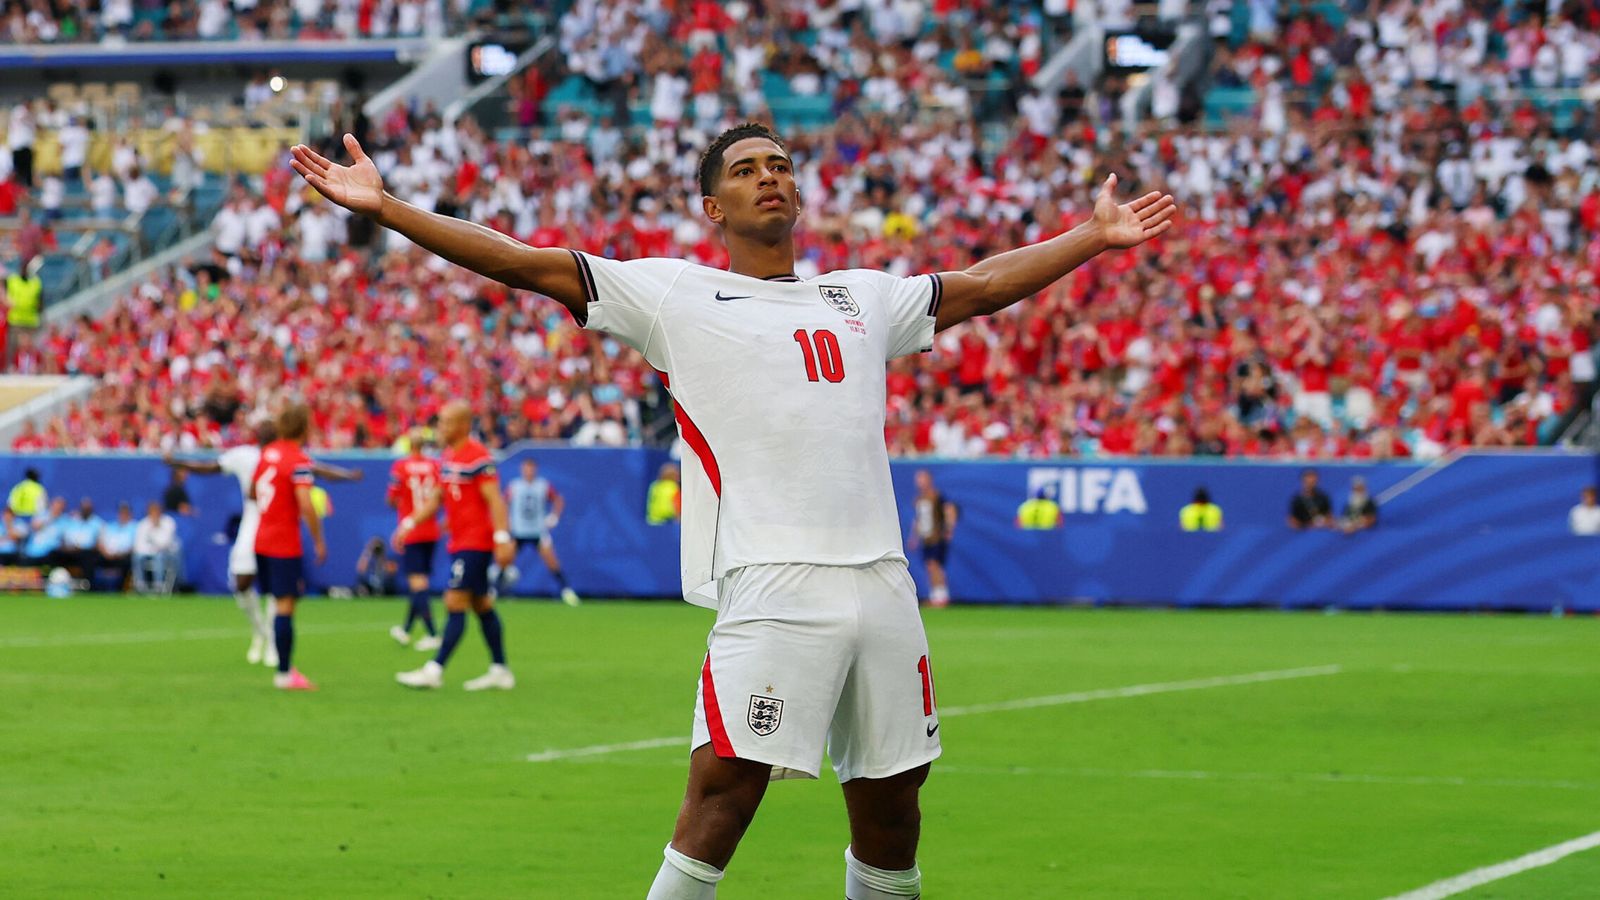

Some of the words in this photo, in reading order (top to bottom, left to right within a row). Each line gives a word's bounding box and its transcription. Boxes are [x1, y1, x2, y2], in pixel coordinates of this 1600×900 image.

[794, 329, 845, 383] 10
[1027, 468, 1147, 514] FIFA
[917, 655, 937, 717] 1
